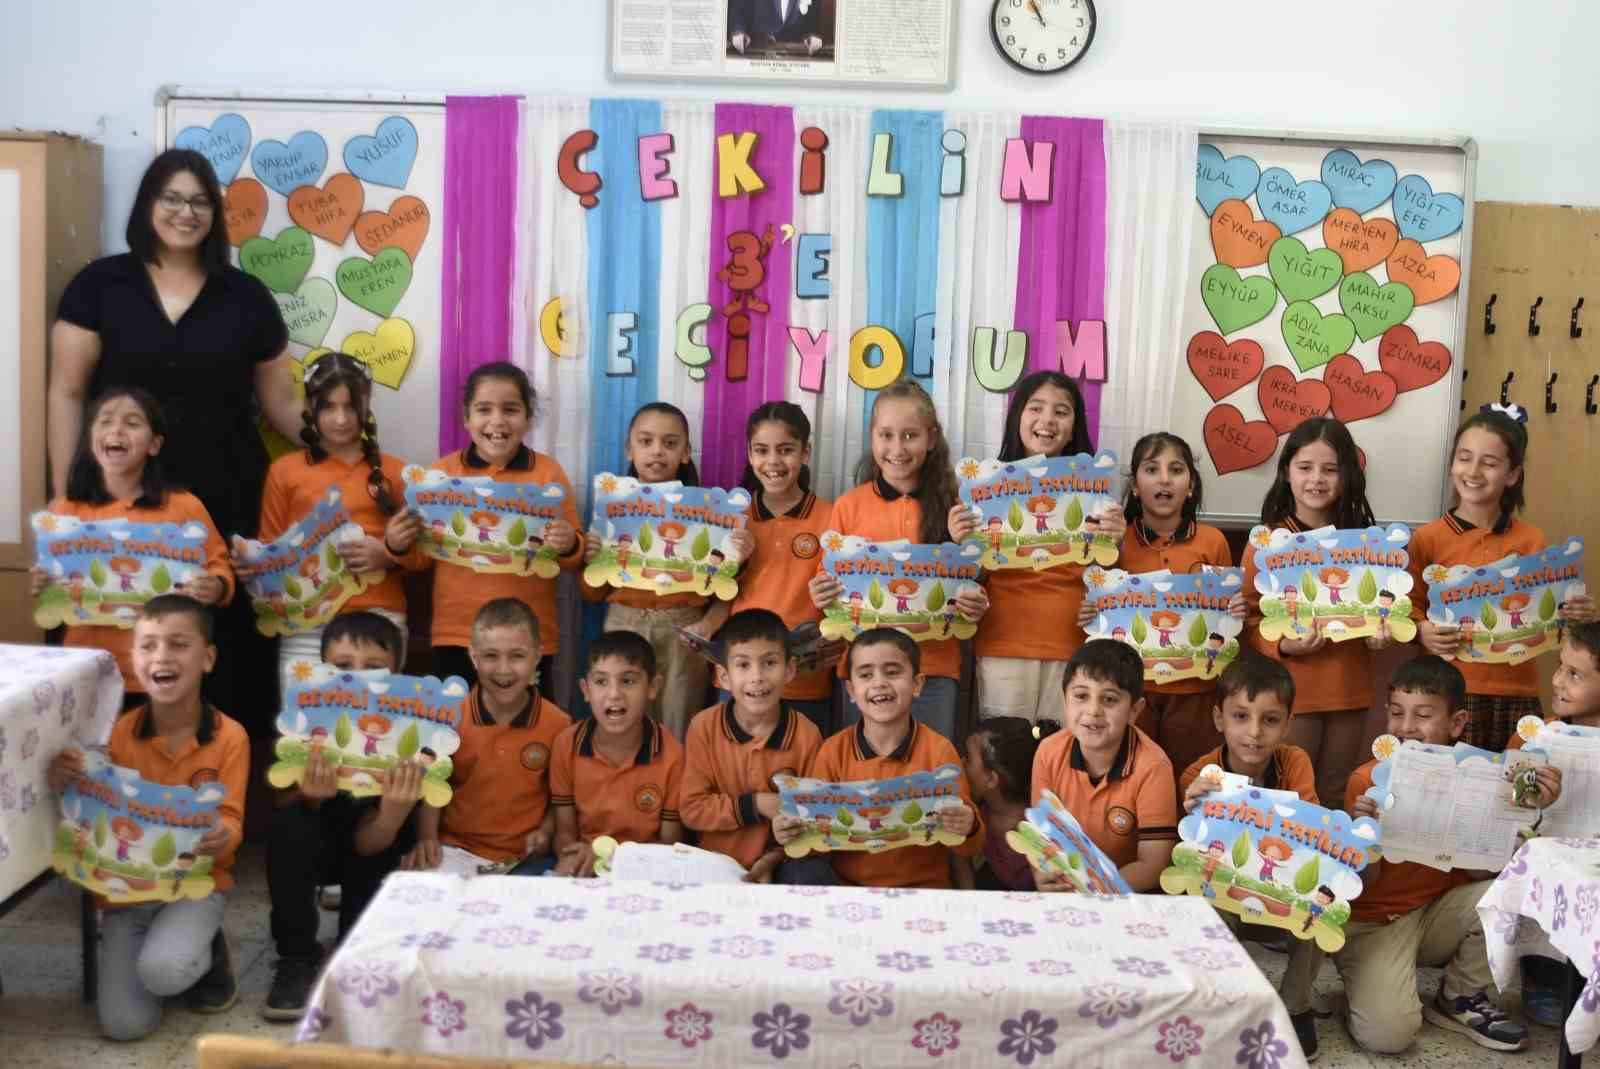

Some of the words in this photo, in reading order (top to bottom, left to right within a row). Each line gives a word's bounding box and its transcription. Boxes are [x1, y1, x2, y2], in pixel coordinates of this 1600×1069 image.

[1001, 16, 1011, 27] 9
[1076, 17, 1085, 28] 3
[1006, 34, 1016, 46] 8
[1070, 35, 1078, 46] 4
[1019, 47, 1027, 59] 7
[1037, 53, 1047, 64] 6
[1057, 48, 1066, 59] 5
[356, 129, 406, 167] YUSUF
[1266, 175, 1306, 203] ÖMER
[1271, 201, 1308, 216] ASAF
[1218, 212, 1270, 250] EYMEN
[1402, 210, 1429, 231] EFE
[342, 257, 402, 283] MUSTAFA
[1393, 255, 1436, 283] AZRA
[361, 275, 395, 297] EREN
[1350, 302, 1389, 321] AKSU
[1295, 335, 1330, 360] ZANA
[1329, 370, 1385, 401] HASAN
[1209, 421, 1257, 453] ASEL
